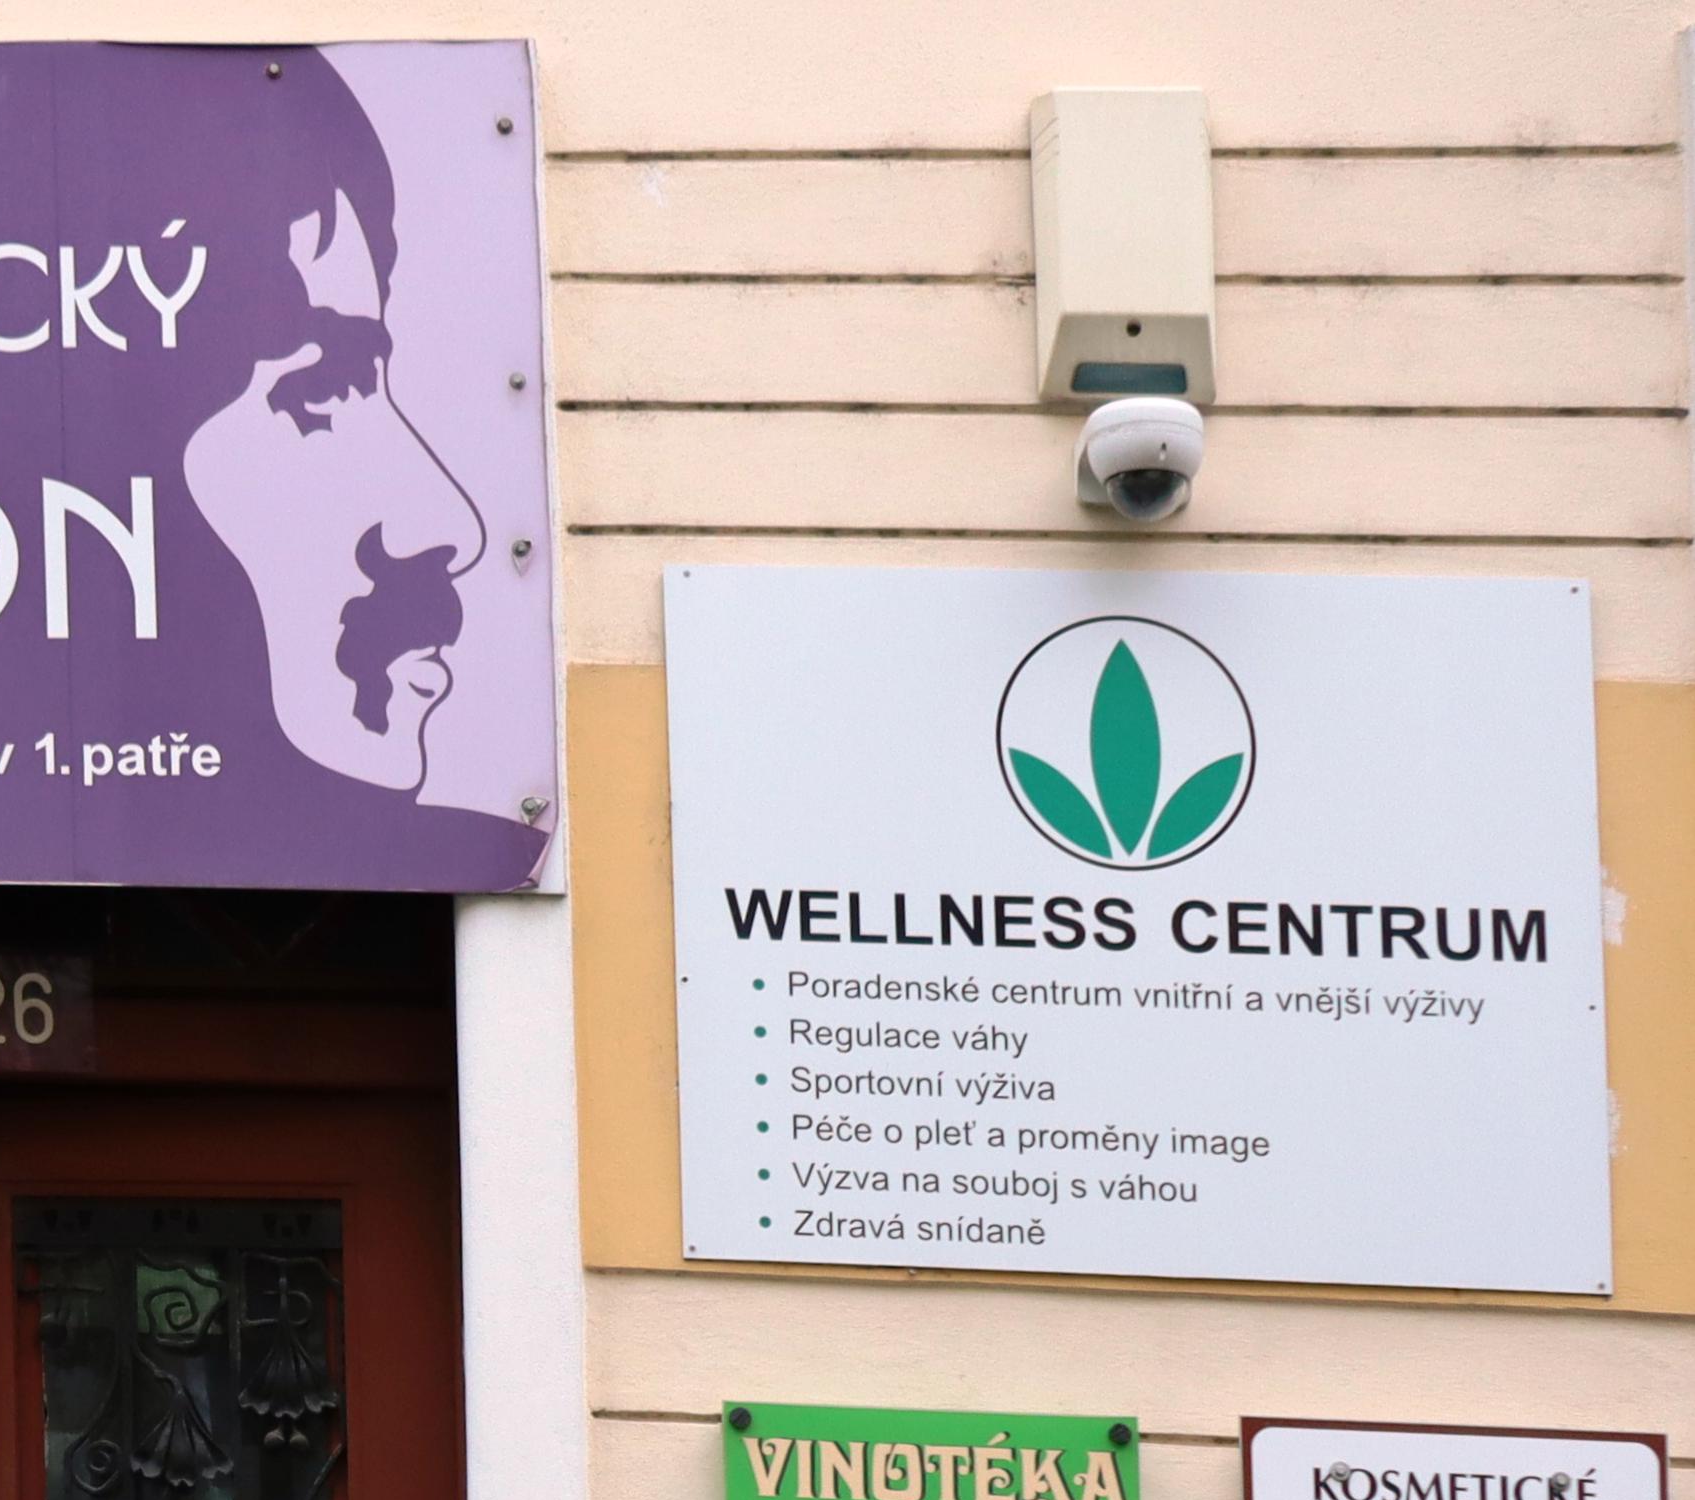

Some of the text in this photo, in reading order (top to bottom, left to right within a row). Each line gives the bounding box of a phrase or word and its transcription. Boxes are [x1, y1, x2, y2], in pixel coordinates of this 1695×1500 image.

[37, 733, 71, 776] 1.
[82, 733, 221, 784] patře
[724, 888, 1548, 963] WELLNESS CENTRUM
[787, 970, 1485, 1025] Poradenské centrum vnitřní a vnější výživy
[789, 1018, 1028, 1059] Regulace váhy
[791, 1066, 1056, 1105] Sportovní výživa
[792, 1114, 1270, 1163] Péče o pleť a proměny image
[792, 1161, 1197, 1204] Výzva na souboj s váhou
[793, 1208, 1046, 1246] Zdravá snídaně
